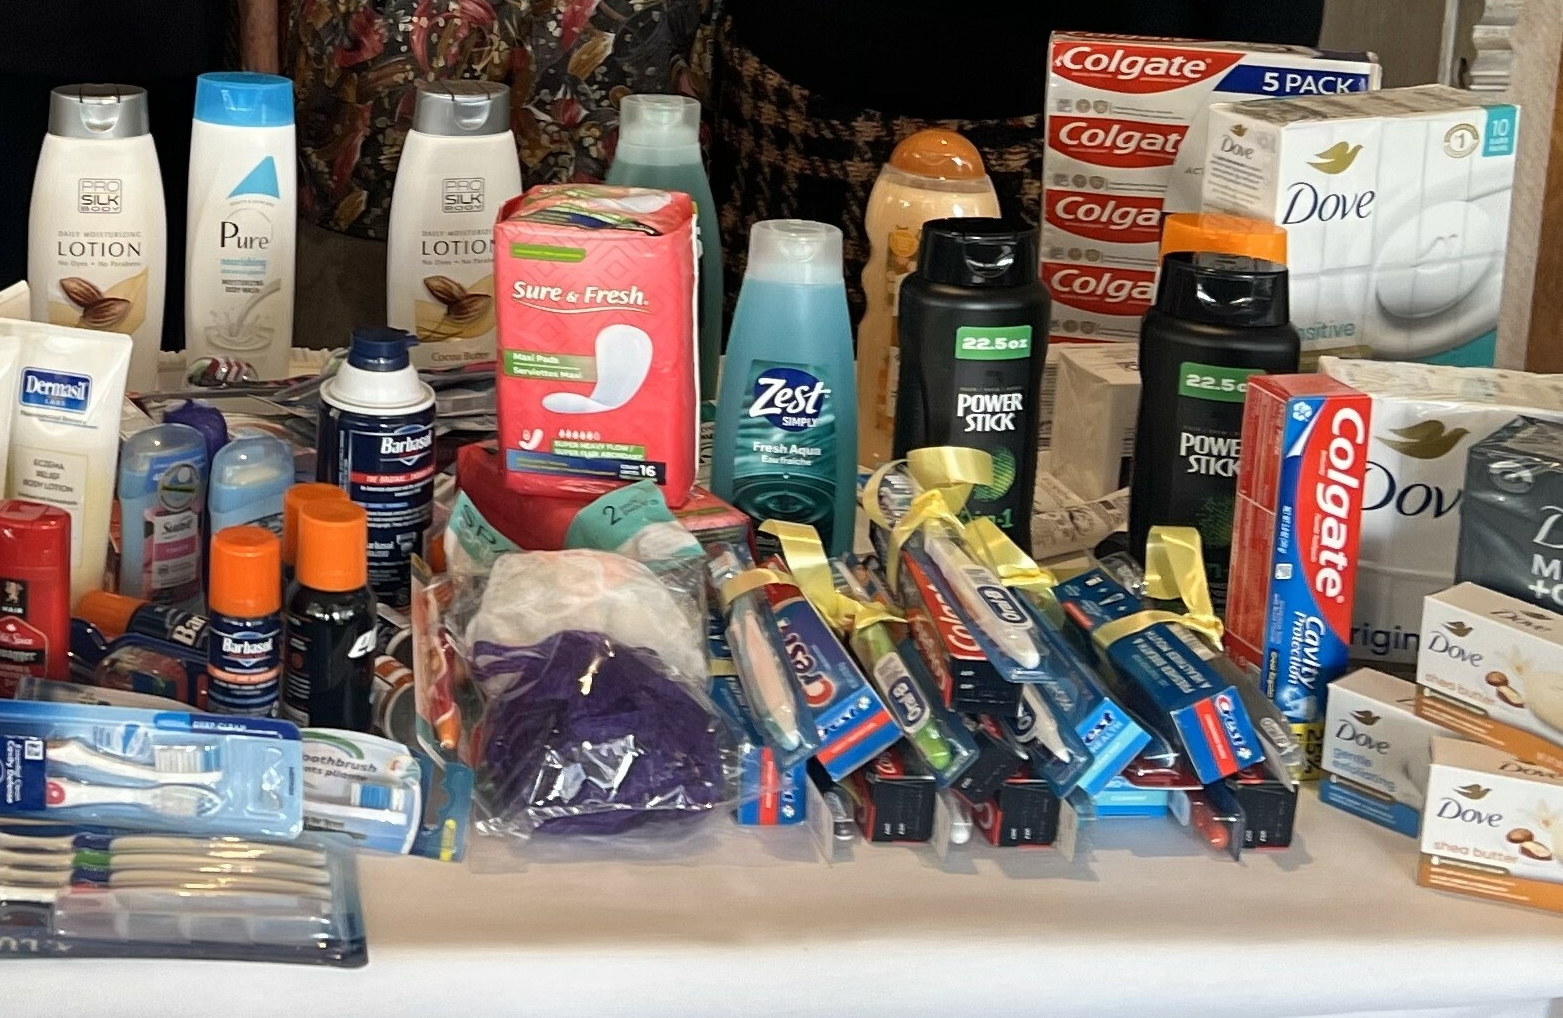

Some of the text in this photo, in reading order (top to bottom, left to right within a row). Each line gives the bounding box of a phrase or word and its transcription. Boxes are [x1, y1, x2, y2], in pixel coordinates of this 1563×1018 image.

[1062, 45, 1207, 80] Colgate
[1262, 74, 1354, 95] 5 PACK
[1058, 121, 1182, 154] Colgat
[1491, 118, 1510, 137] 10
[1221, 134, 1256, 160] Dove
[81, 180, 120, 193] PRO
[444, 180, 483, 191] PRO
[81, 194, 120, 206] SILK
[444, 194, 483, 205] SILK
[1281, 181, 1376, 225] Dove
[1054, 196, 1161, 230] Colga
[220, 220, 270, 250] Pure
[57, 241, 142, 257] LOTION
[512, 280, 645, 307] Sure & Fresh
[962, 337, 1028, 351] 22.5oz
[463, 351, 490, 361] Butter
[513, 353, 560, 364] Maxi Pads
[560, 370, 583, 379] Maxi
[26, 373, 88, 401] Dermasil
[748, 376, 831, 418] Zest
[956, 393, 1023, 417] POWER
[782, 416, 821, 428] SIMPLY
[964, 413, 1017, 433] STICK
[380, 431, 433, 455] Barbasol
[753, 441, 822, 457] Fresh Aqua
[639, 463, 657, 477] 16
[761, 455, 777, 464] Eau
[1315, 406, 1366, 599] Colgate
[602, 505, 621, 526] 2
[985, 588, 1019, 622] Oral-B
[222, 637, 274, 654] Barbasol
[1288, 610, 1307, 686] Protection
[1303, 614, 1327, 691] Cavity
[1428, 630, 1484, 667] Dove
[891, 681, 922, 721] Oral-B
[1335, 719, 1391, 755] Dove
[1436, 797, 1504, 829] Dove
[1433, 840, 1518, 863] shea butter
